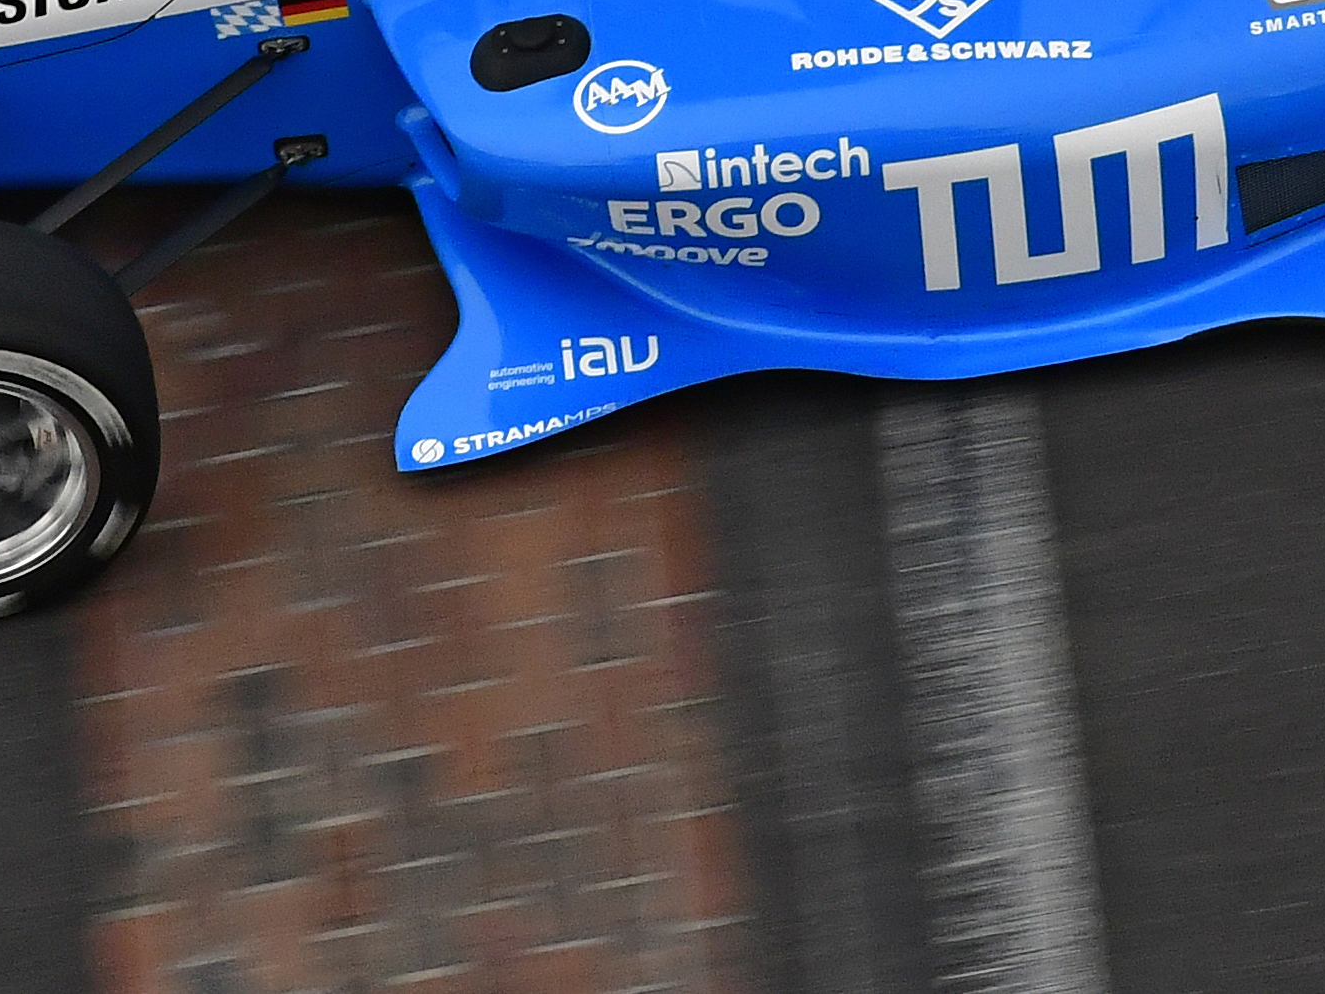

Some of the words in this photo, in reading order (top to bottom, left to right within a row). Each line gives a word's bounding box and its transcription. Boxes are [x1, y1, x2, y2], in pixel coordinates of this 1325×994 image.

[791, 40, 1093, 71] ROHDE&SCHWARZ
[586, 68, 671, 112] AAM
[705, 136, 870, 189] intech
[882, 93, 1229, 291] TUM
[608, 192, 820, 238] ERGO
[490, 361, 554, 378] automotive
[561, 335, 659, 380] iav
[488, 373, 555, 391] engineering
